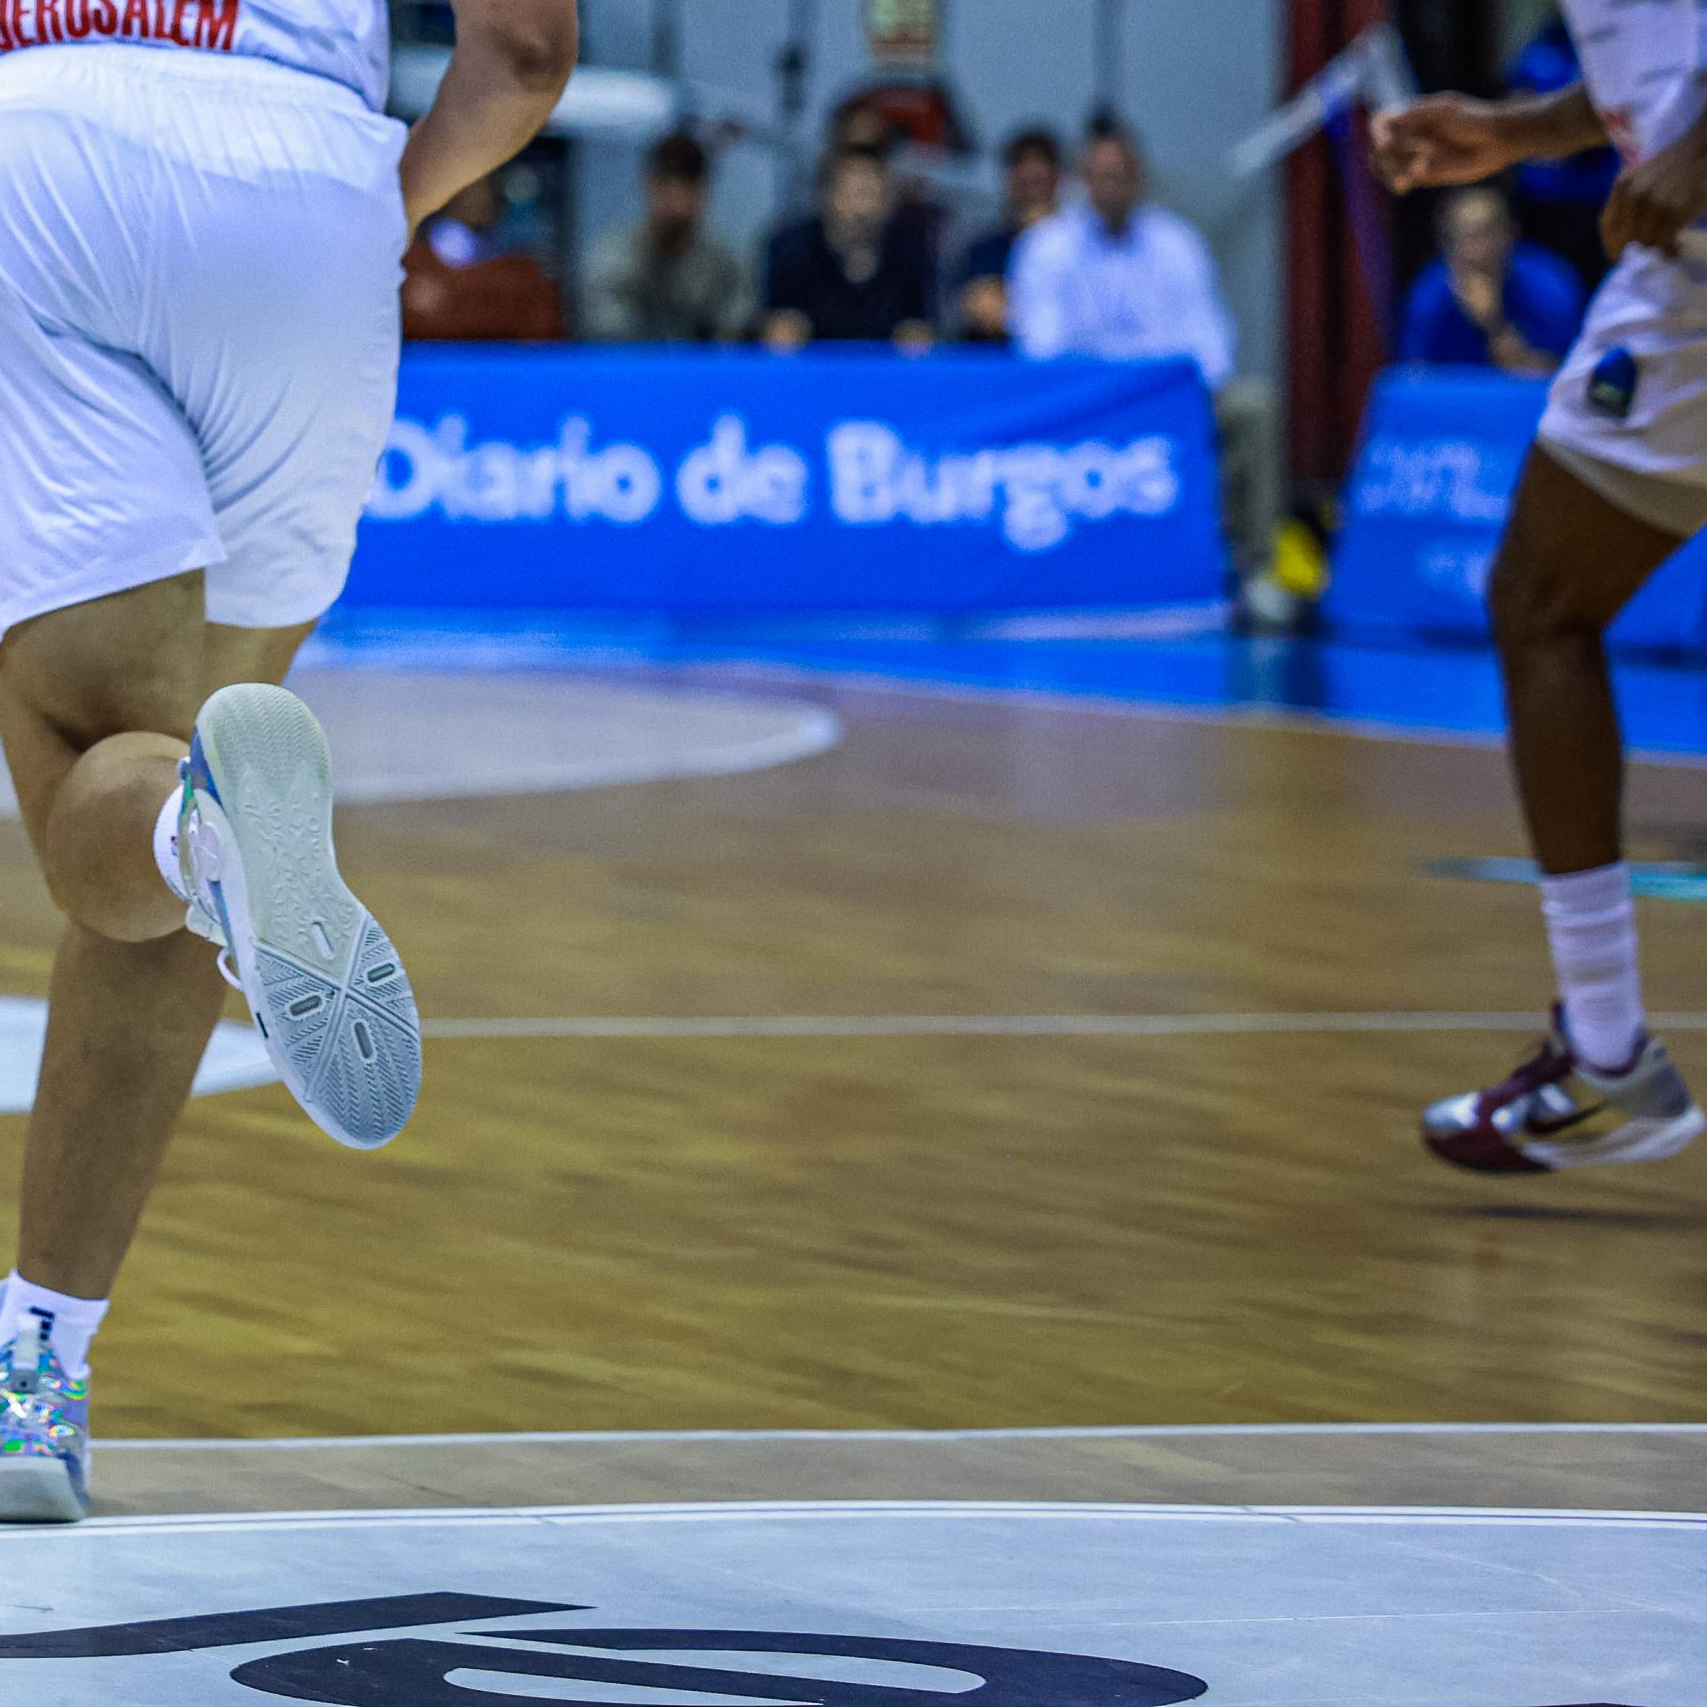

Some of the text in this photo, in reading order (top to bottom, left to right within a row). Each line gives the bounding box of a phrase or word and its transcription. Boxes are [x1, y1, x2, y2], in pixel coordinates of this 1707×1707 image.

[363, 412, 1179, 551] Diario de Burgos
